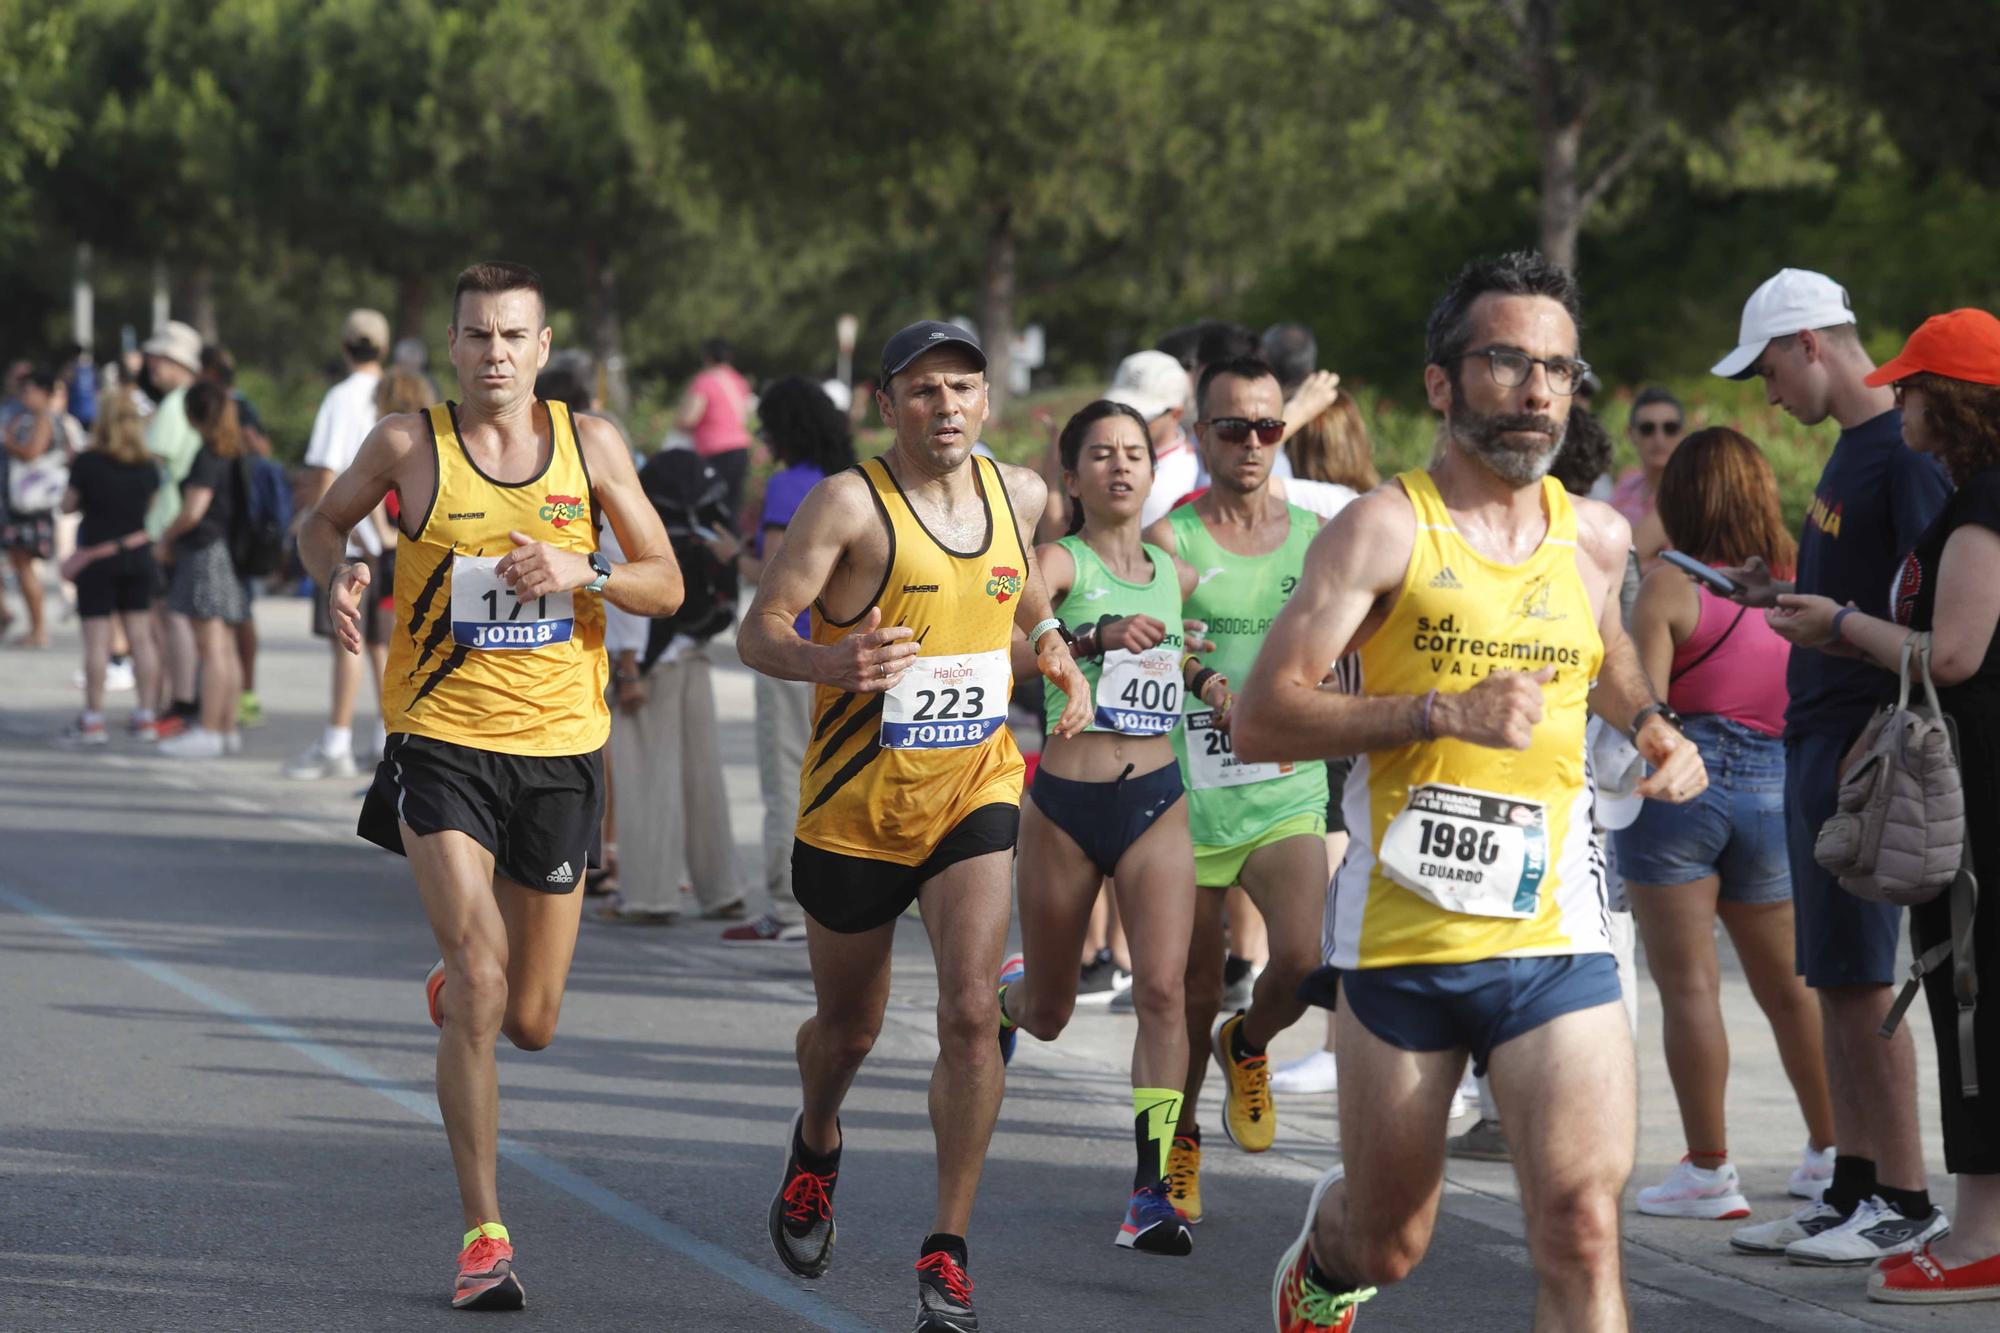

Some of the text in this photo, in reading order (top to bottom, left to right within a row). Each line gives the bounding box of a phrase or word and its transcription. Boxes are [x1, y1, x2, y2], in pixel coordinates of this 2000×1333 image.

[482, 589, 546, 621] 171
[1418, 615, 1460, 633] s.d.
[1413, 635, 1580, 666] correcaminos
[912, 686, 985, 721] 223
[1121, 678, 1177, 712] 400
[1204, 731, 1233, 756] 20
[1418, 862, 1484, 884] EDUARDO
